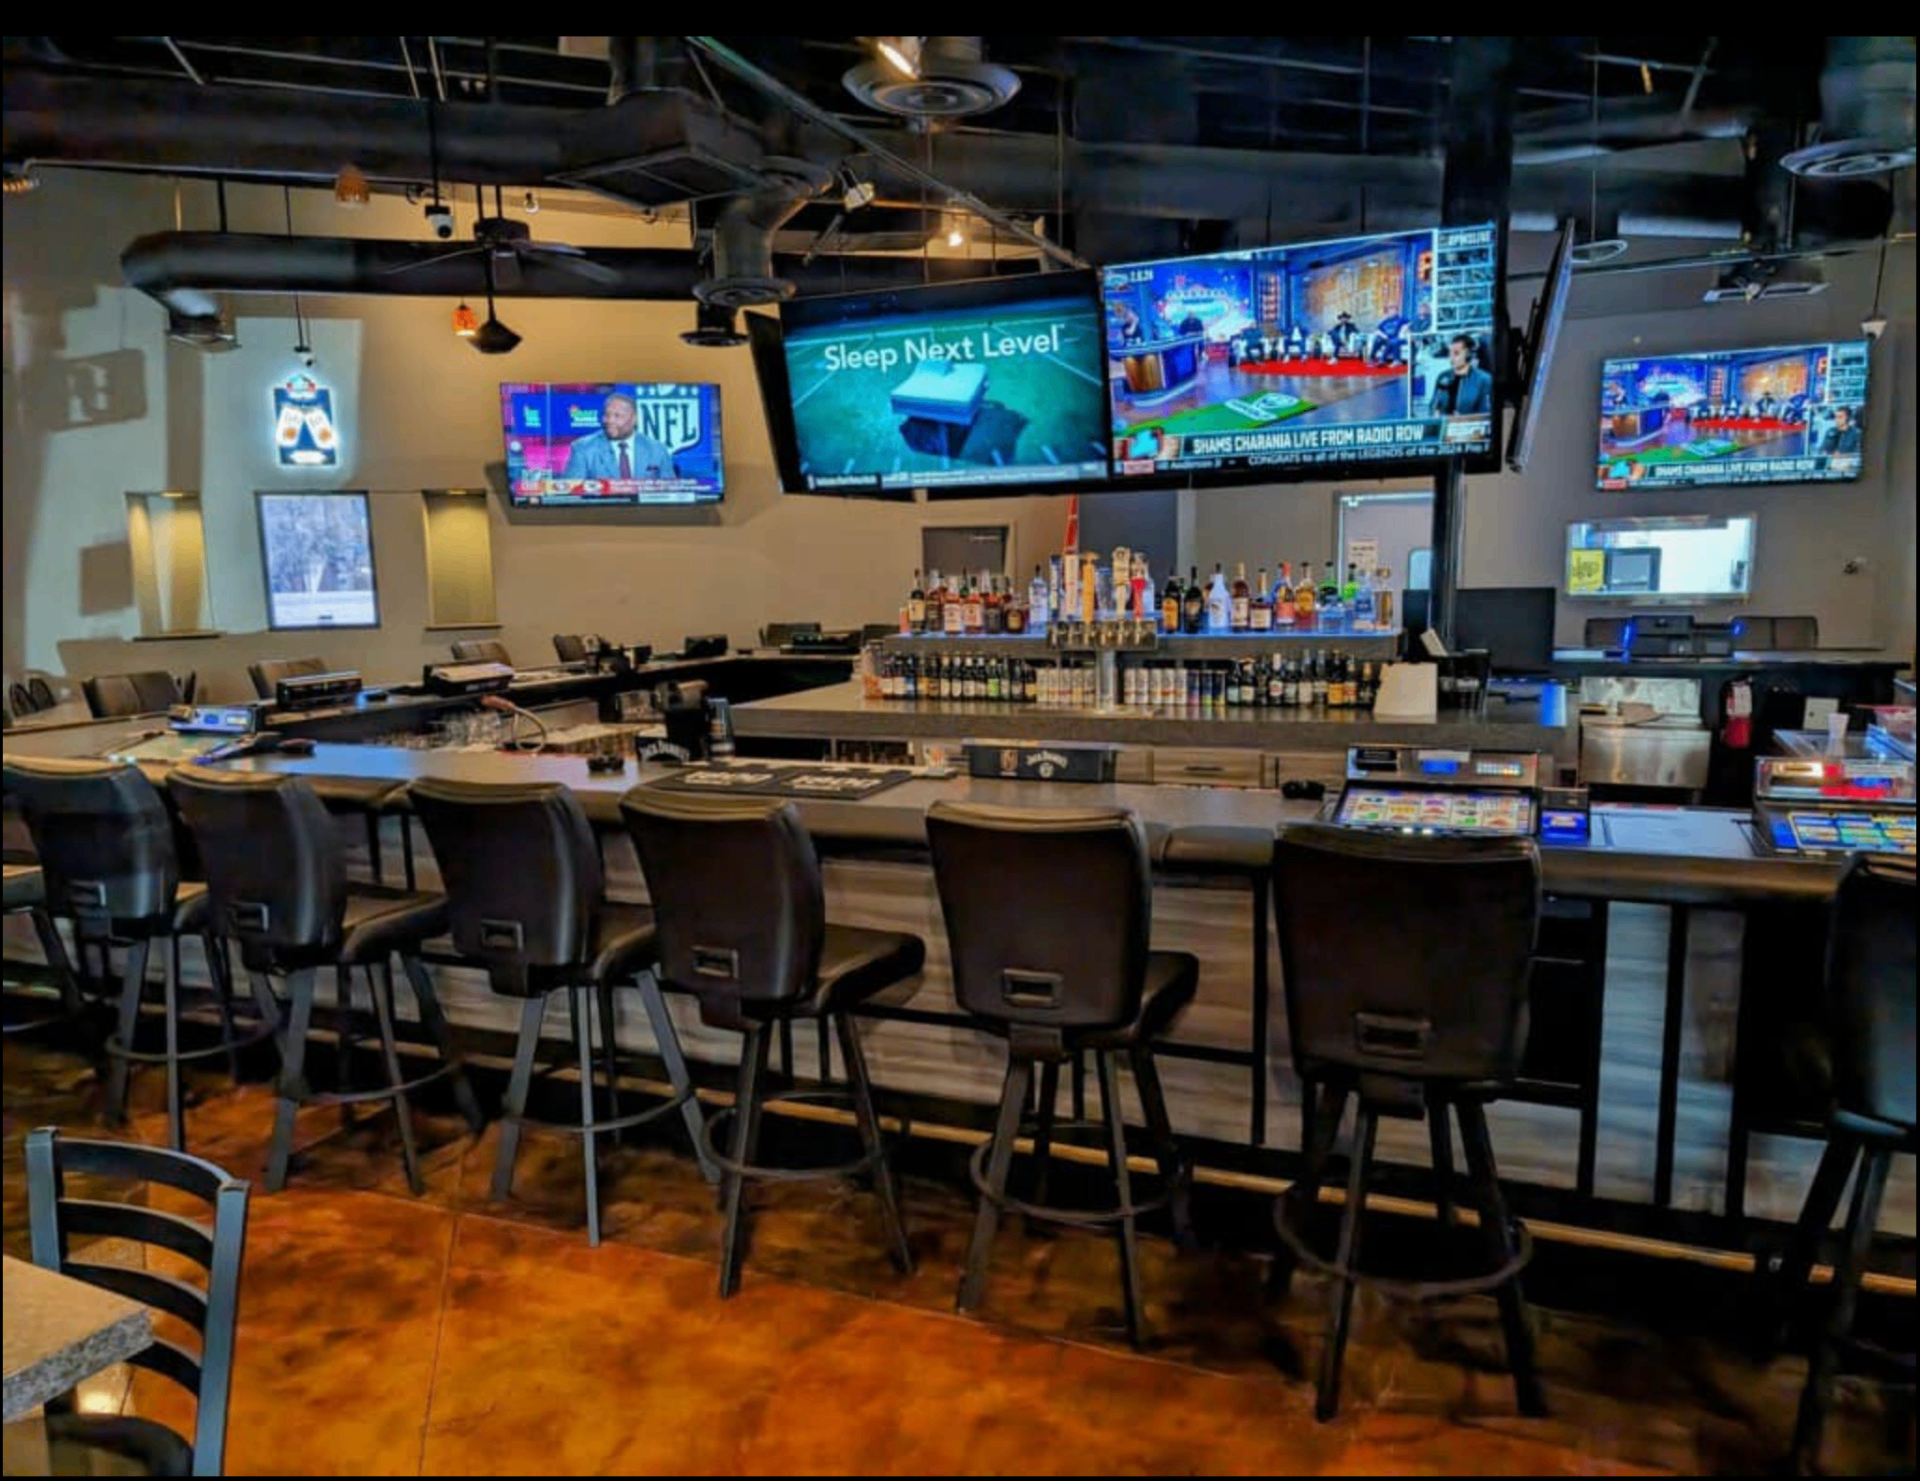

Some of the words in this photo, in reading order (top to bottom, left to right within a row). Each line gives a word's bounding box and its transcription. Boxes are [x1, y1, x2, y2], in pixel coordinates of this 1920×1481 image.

[824, 343, 897, 372] Sleep
[904, 336, 975, 364] Next
[982, 324, 1060, 358] Level
[640, 403, 698, 448] NFL
[1193, 434, 1233, 455] SHAMS
[1235, 431, 1291, 453] CHARANIA
[1293, 429, 1318, 449] LIVE
[1321, 427, 1353, 447] FROM
[1356, 425, 1393, 445] RADIO
[1396, 423, 1424, 442] ROW
